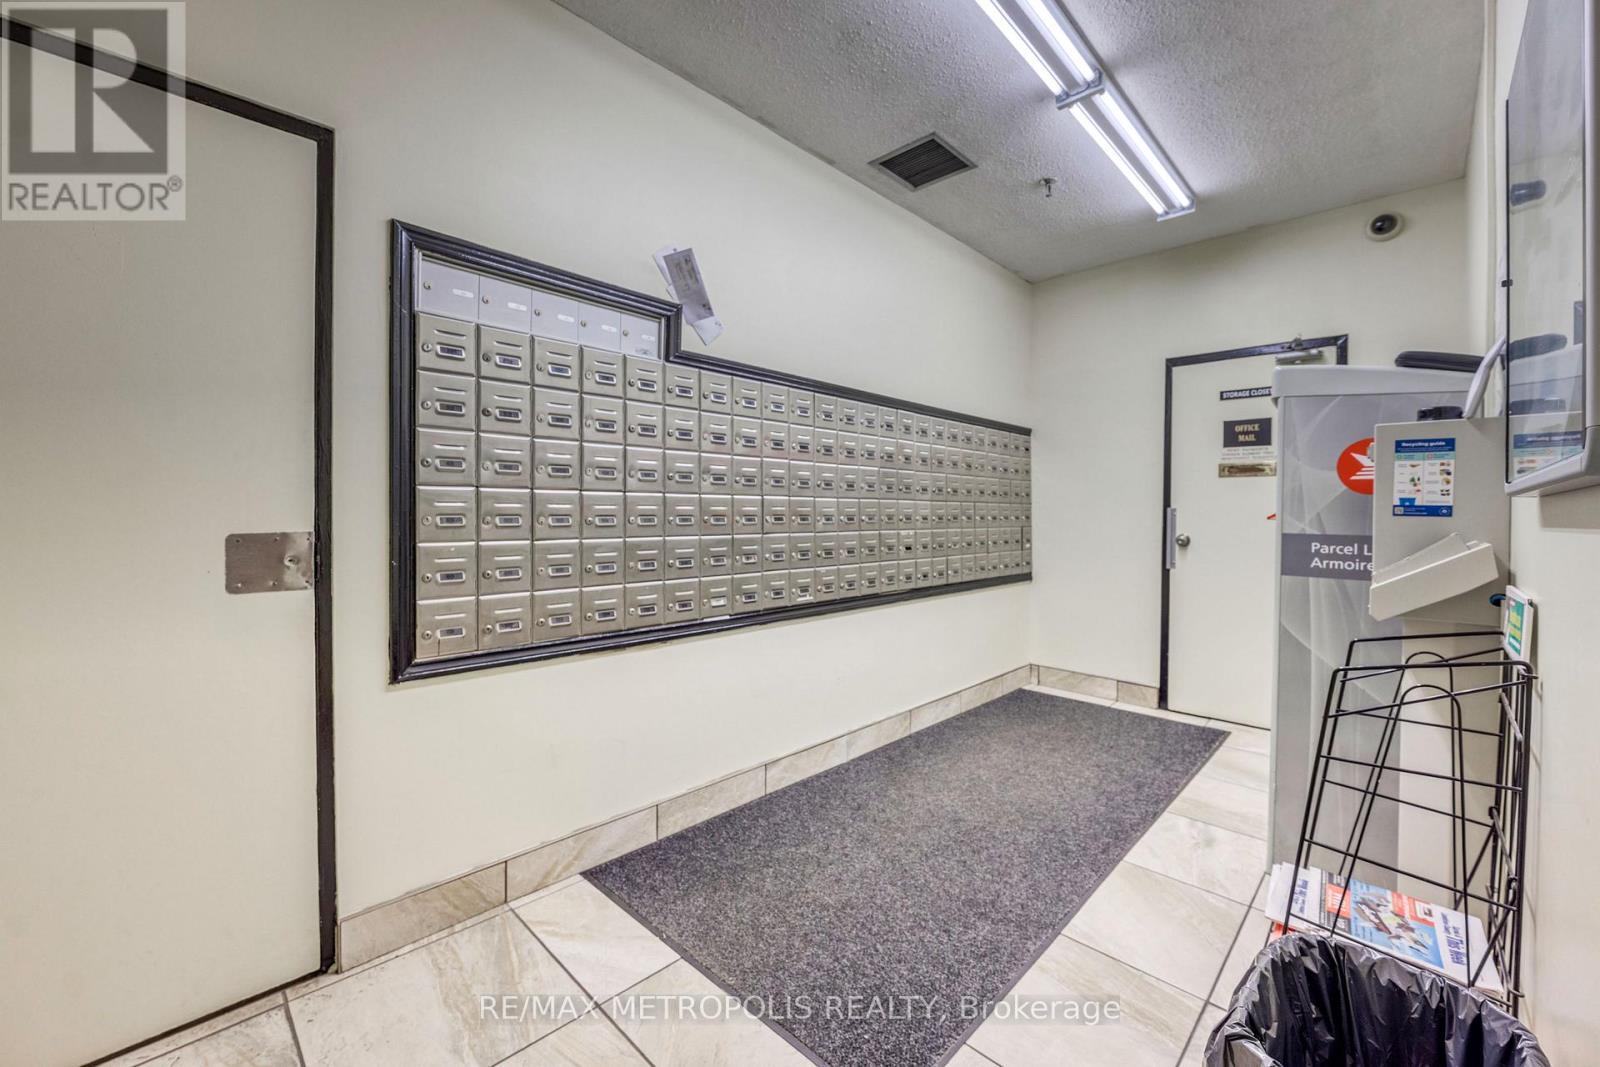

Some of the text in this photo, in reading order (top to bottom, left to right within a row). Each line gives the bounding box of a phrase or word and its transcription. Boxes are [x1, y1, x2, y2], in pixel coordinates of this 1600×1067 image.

[1222, 390, 1250, 399] STORAGE
[1234, 423, 1260, 433] OFFICE
[1237, 434, 1256, 442] MAIL
[1310, 542, 1373, 556] Parcel L
[1310, 557, 1374, 571] Armoire
